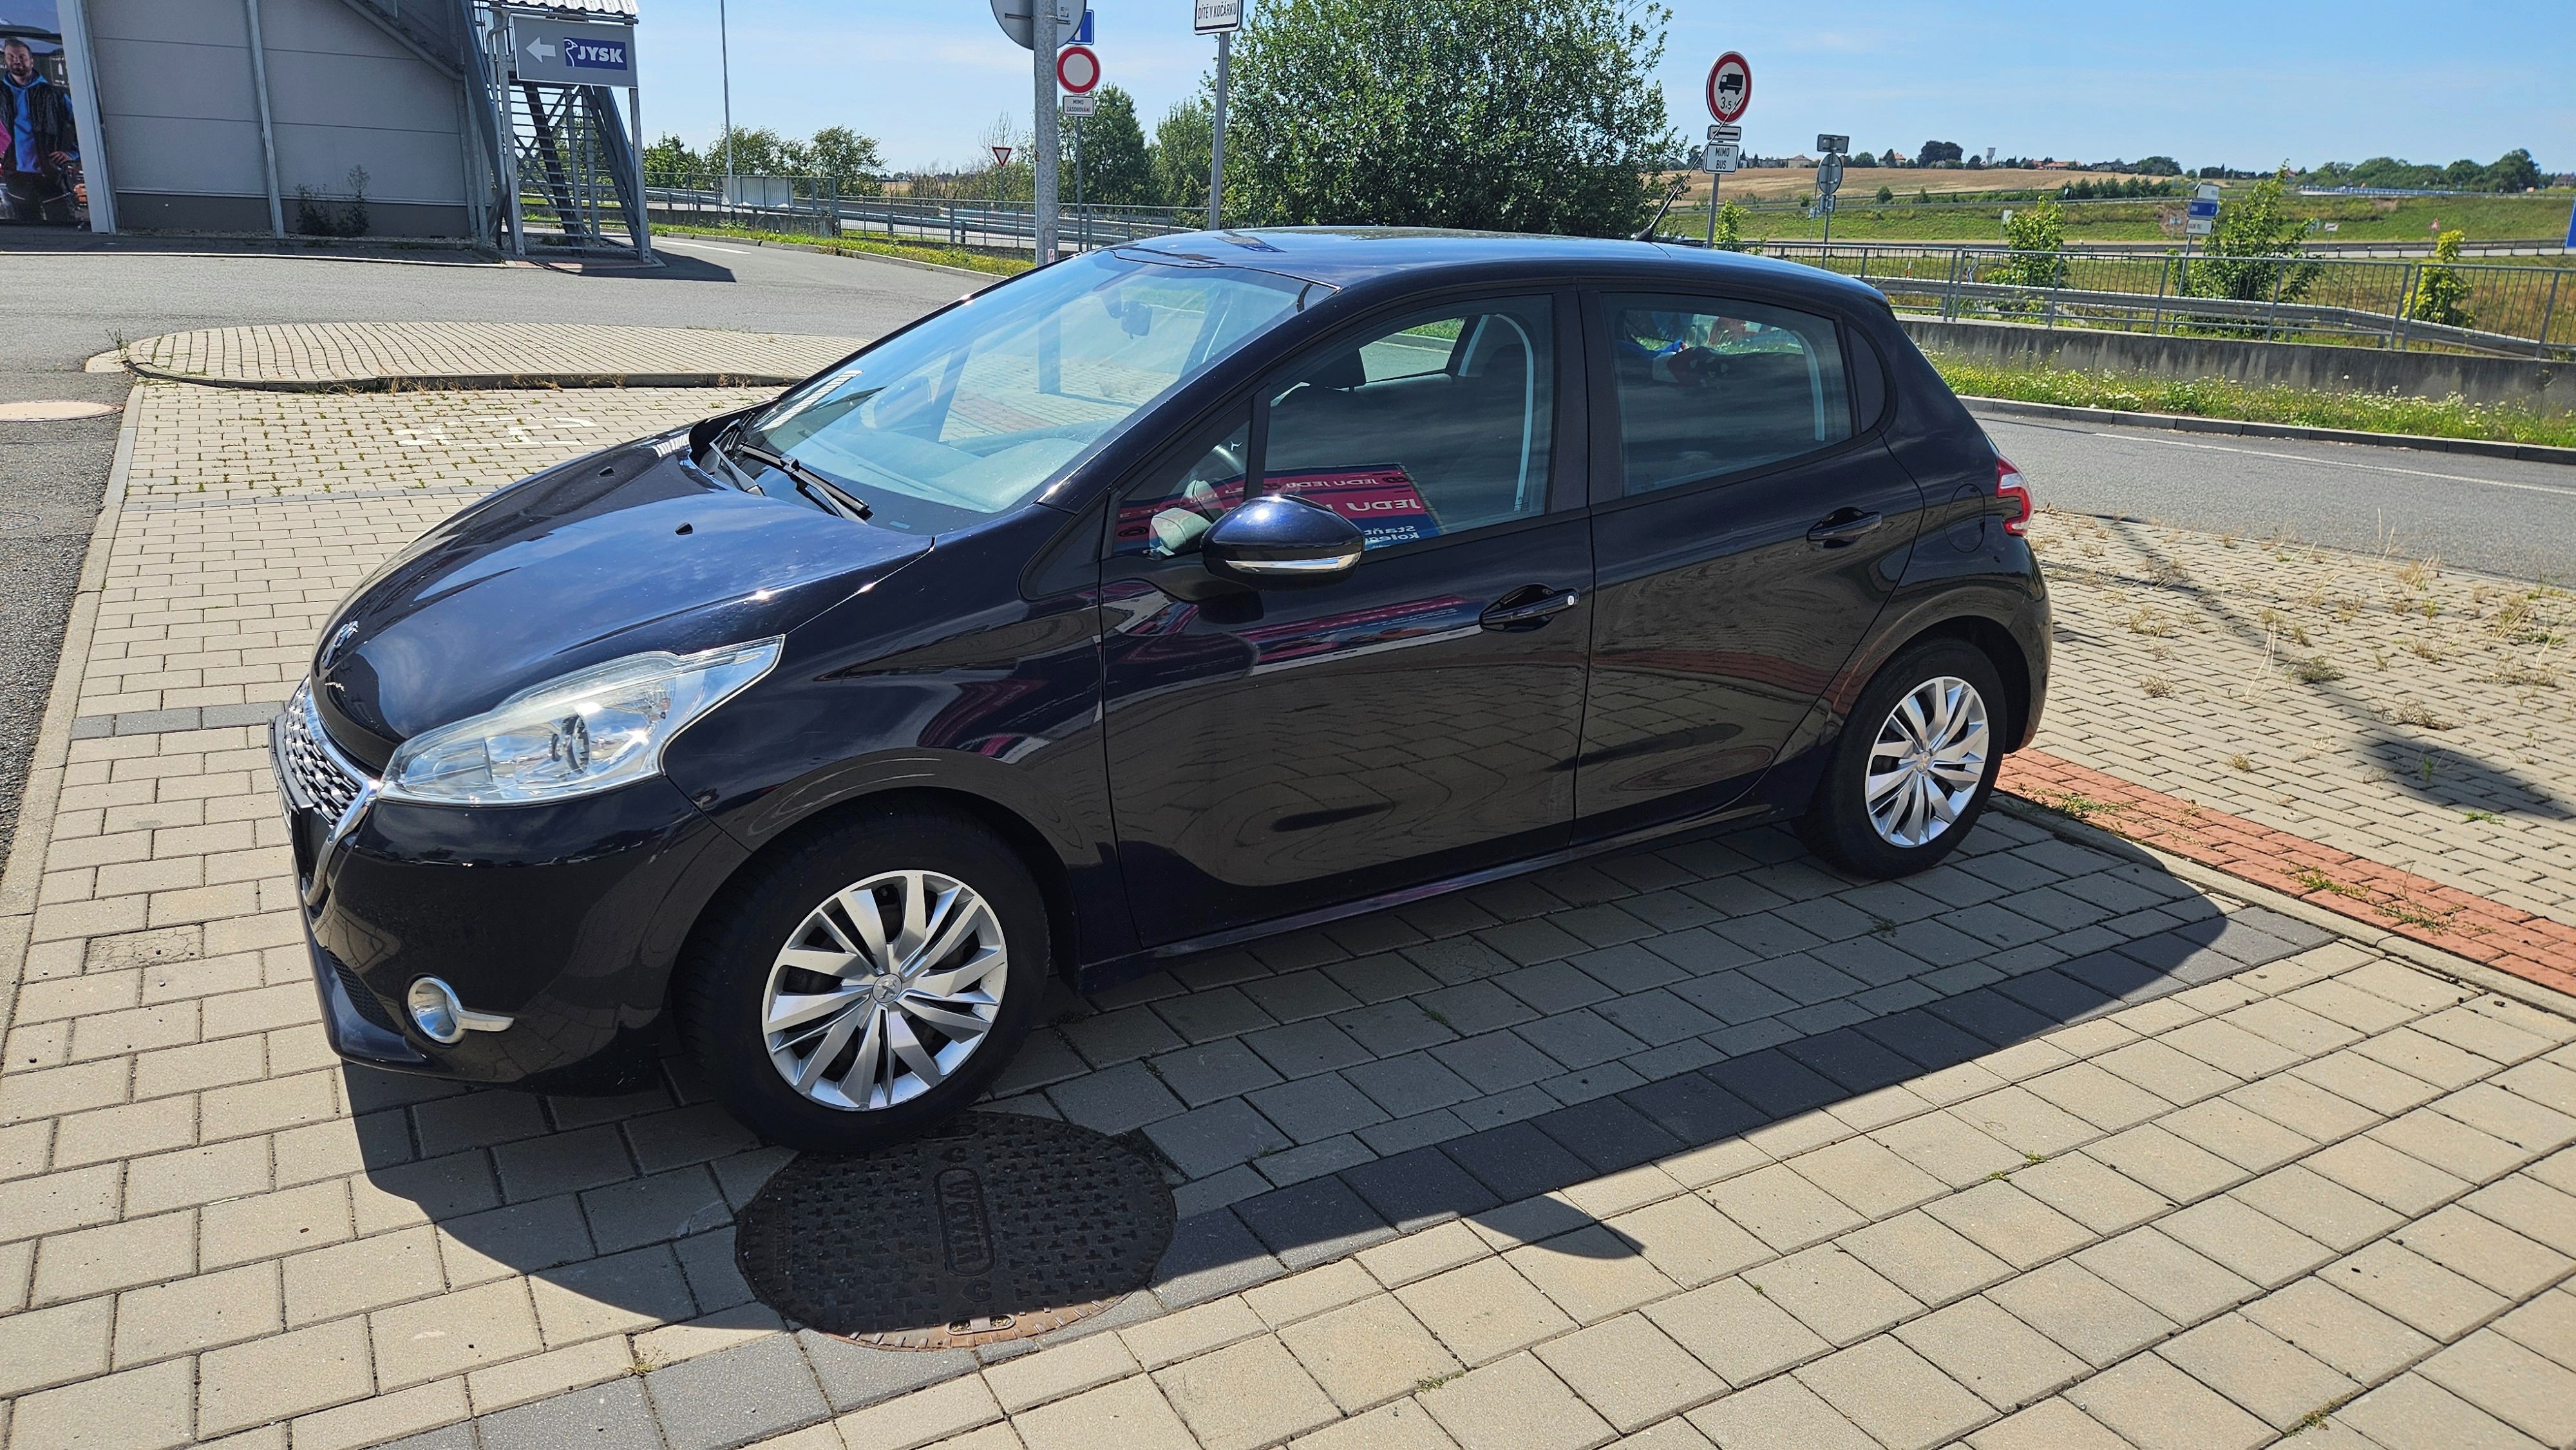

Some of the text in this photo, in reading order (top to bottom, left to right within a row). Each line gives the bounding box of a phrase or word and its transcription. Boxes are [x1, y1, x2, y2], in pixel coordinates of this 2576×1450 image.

[1198, 3, 1209, 19] DÍTĚ
[1213, 1, 1236, 18] KOČÁRKU
[577, 46, 623, 63] JYSK
[1715, 147, 1730, 157] MIMO
[1716, 160, 1727, 169] BUS
